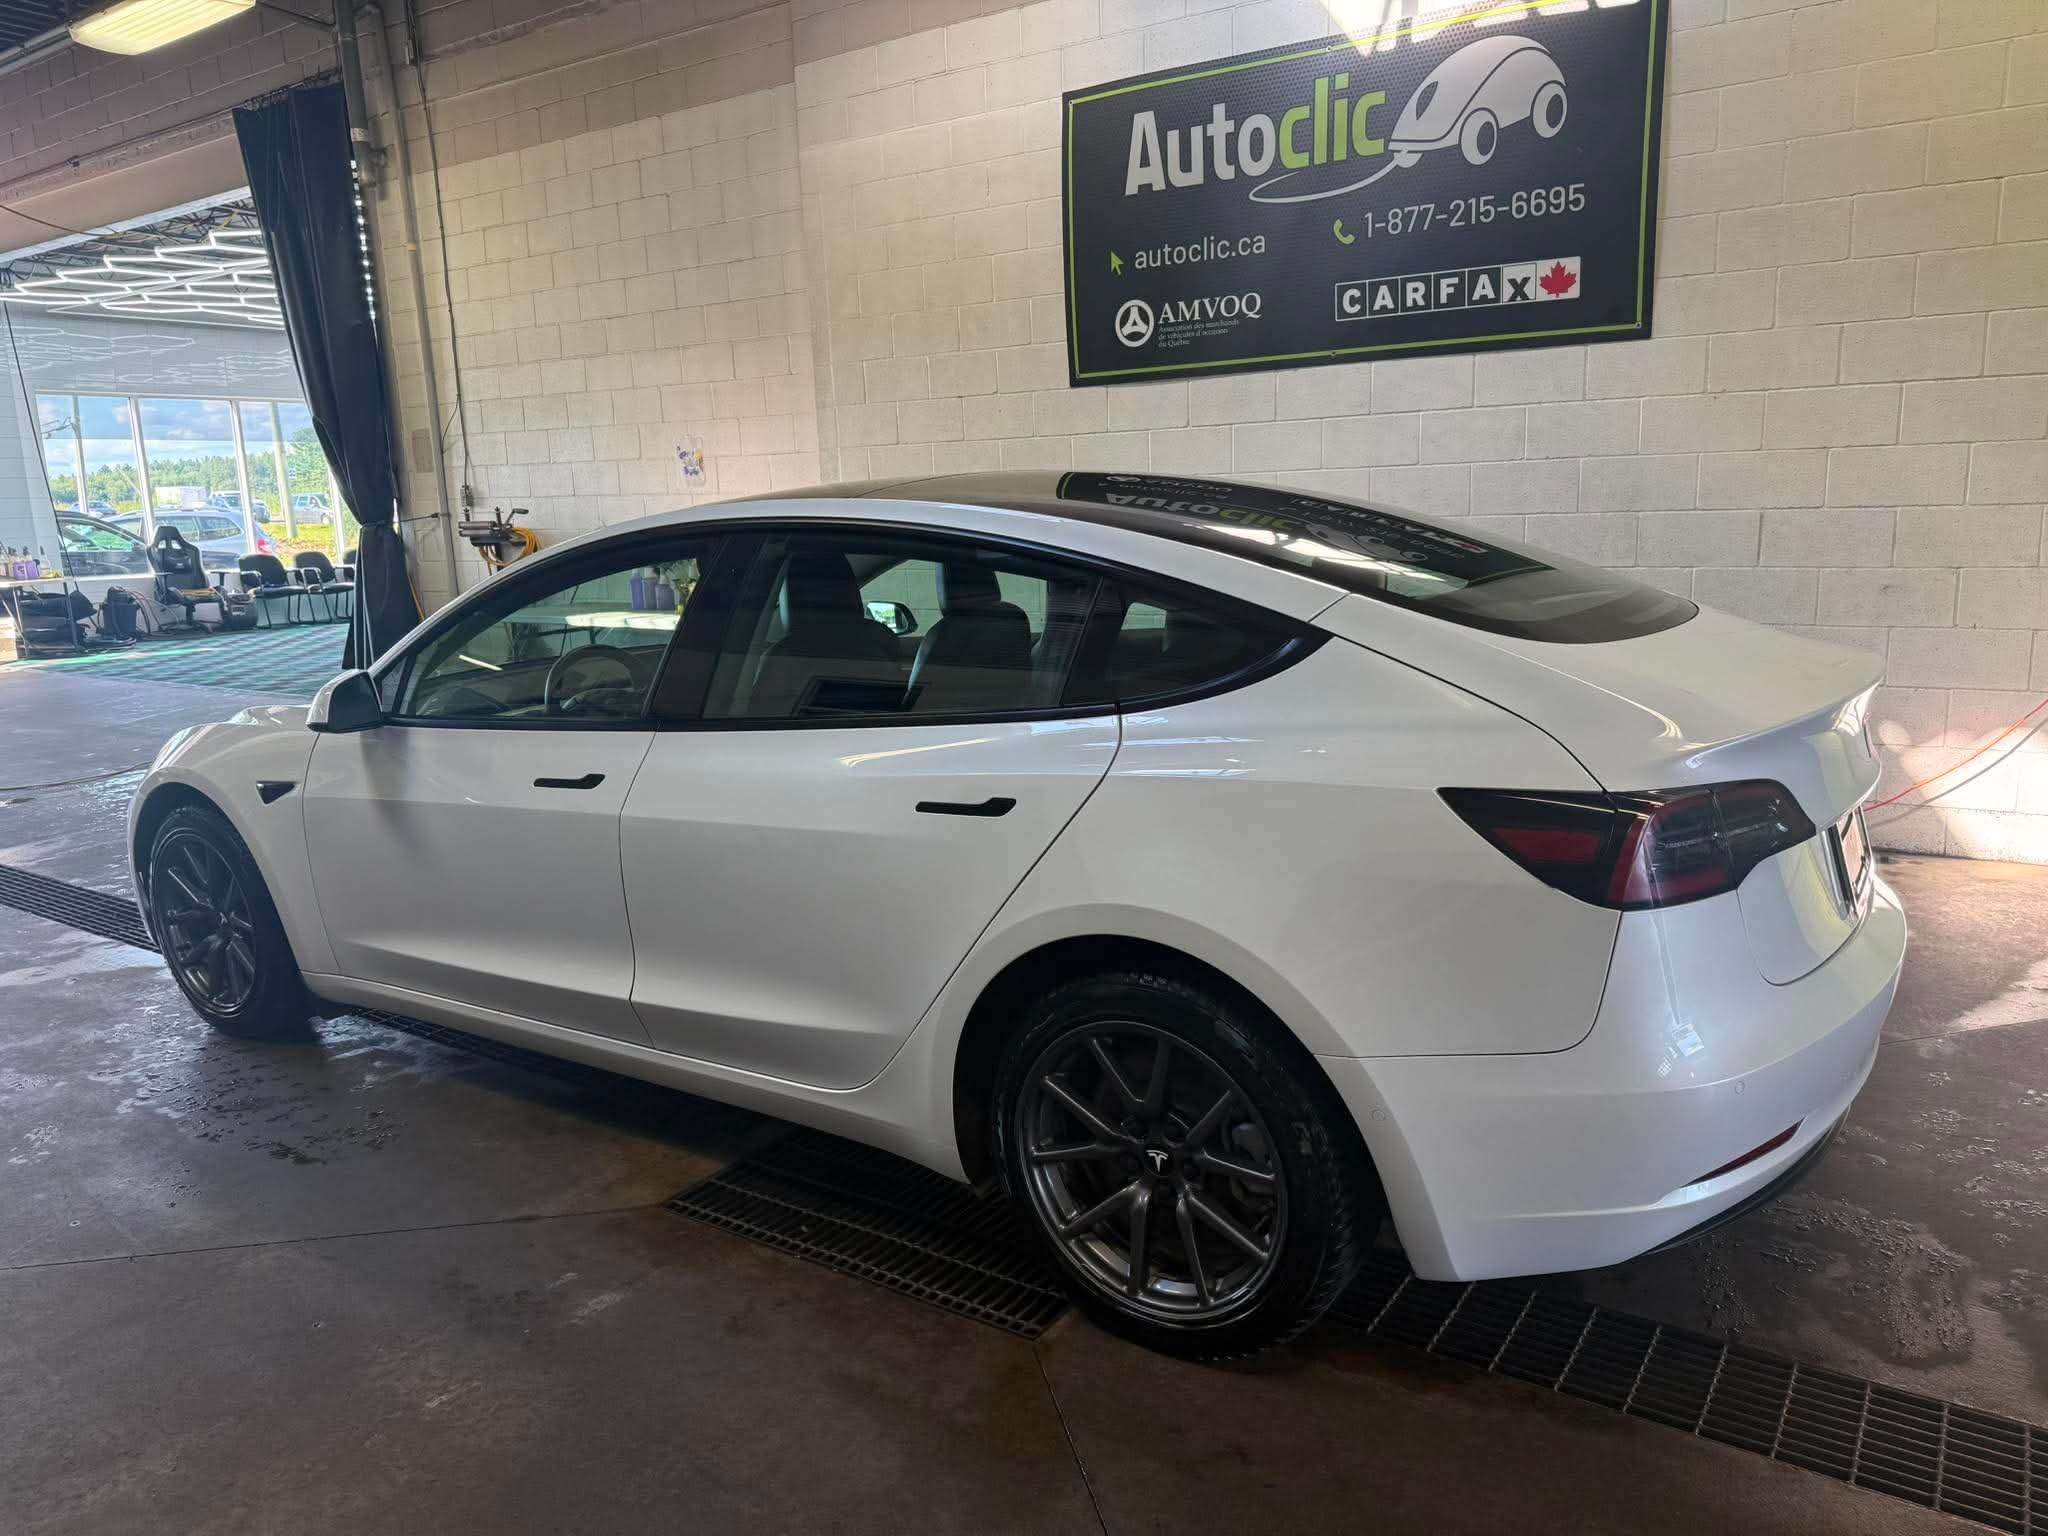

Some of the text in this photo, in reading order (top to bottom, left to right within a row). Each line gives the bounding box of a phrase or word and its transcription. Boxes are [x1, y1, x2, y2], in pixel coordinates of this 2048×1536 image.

[1125, 71, 1386, 196] Autoclic
[1364, 183, 1586, 238] 1-877-215-6695
[1134, 235, 1265, 269] autoclic.ca
[1158, 292, 1263, 324] AMVOQ
[1342, 274, 1532, 314] CARFAX
